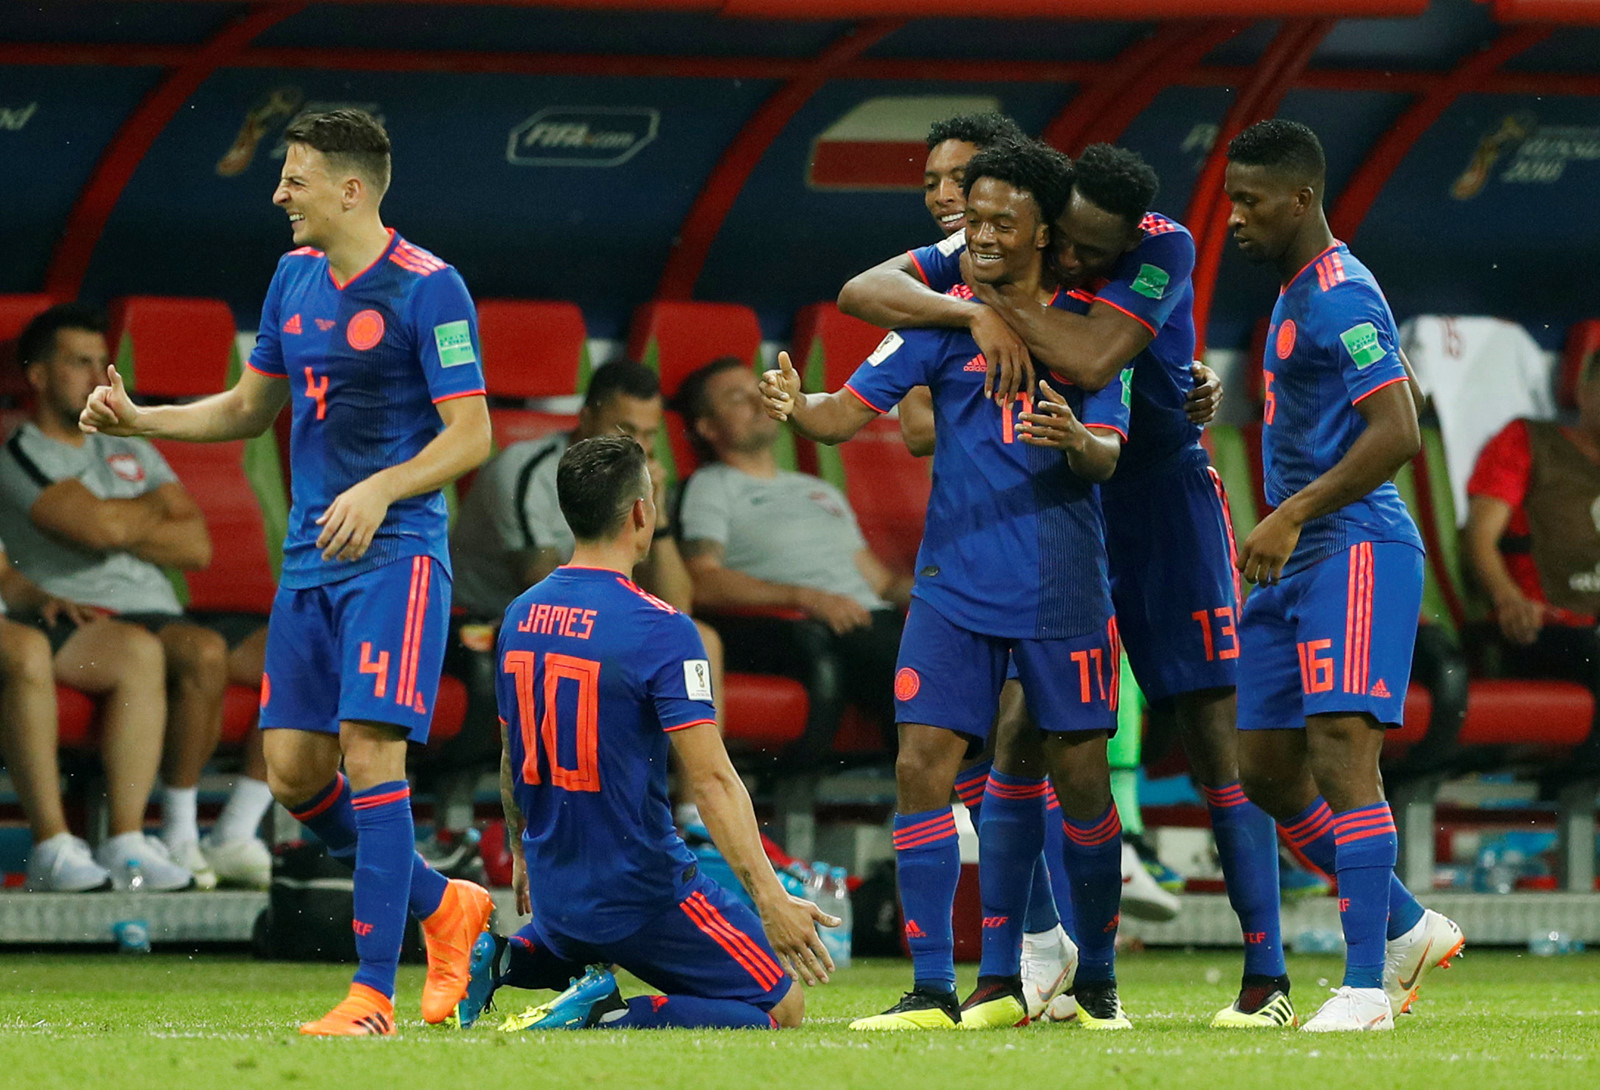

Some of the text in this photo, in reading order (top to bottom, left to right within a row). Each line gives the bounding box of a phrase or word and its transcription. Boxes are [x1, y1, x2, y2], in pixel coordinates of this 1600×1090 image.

[304, 366, 330, 420] 4
[517, 603, 598, 640] JAMES
[1191, 606, 1241, 661] 13
[359, 641, 390, 698] 4
[1070, 648, 1106, 703] 11
[1297, 638, 1334, 695] 16
[503, 650, 602, 792] 10
[982, 916, 1009, 929] FCF
